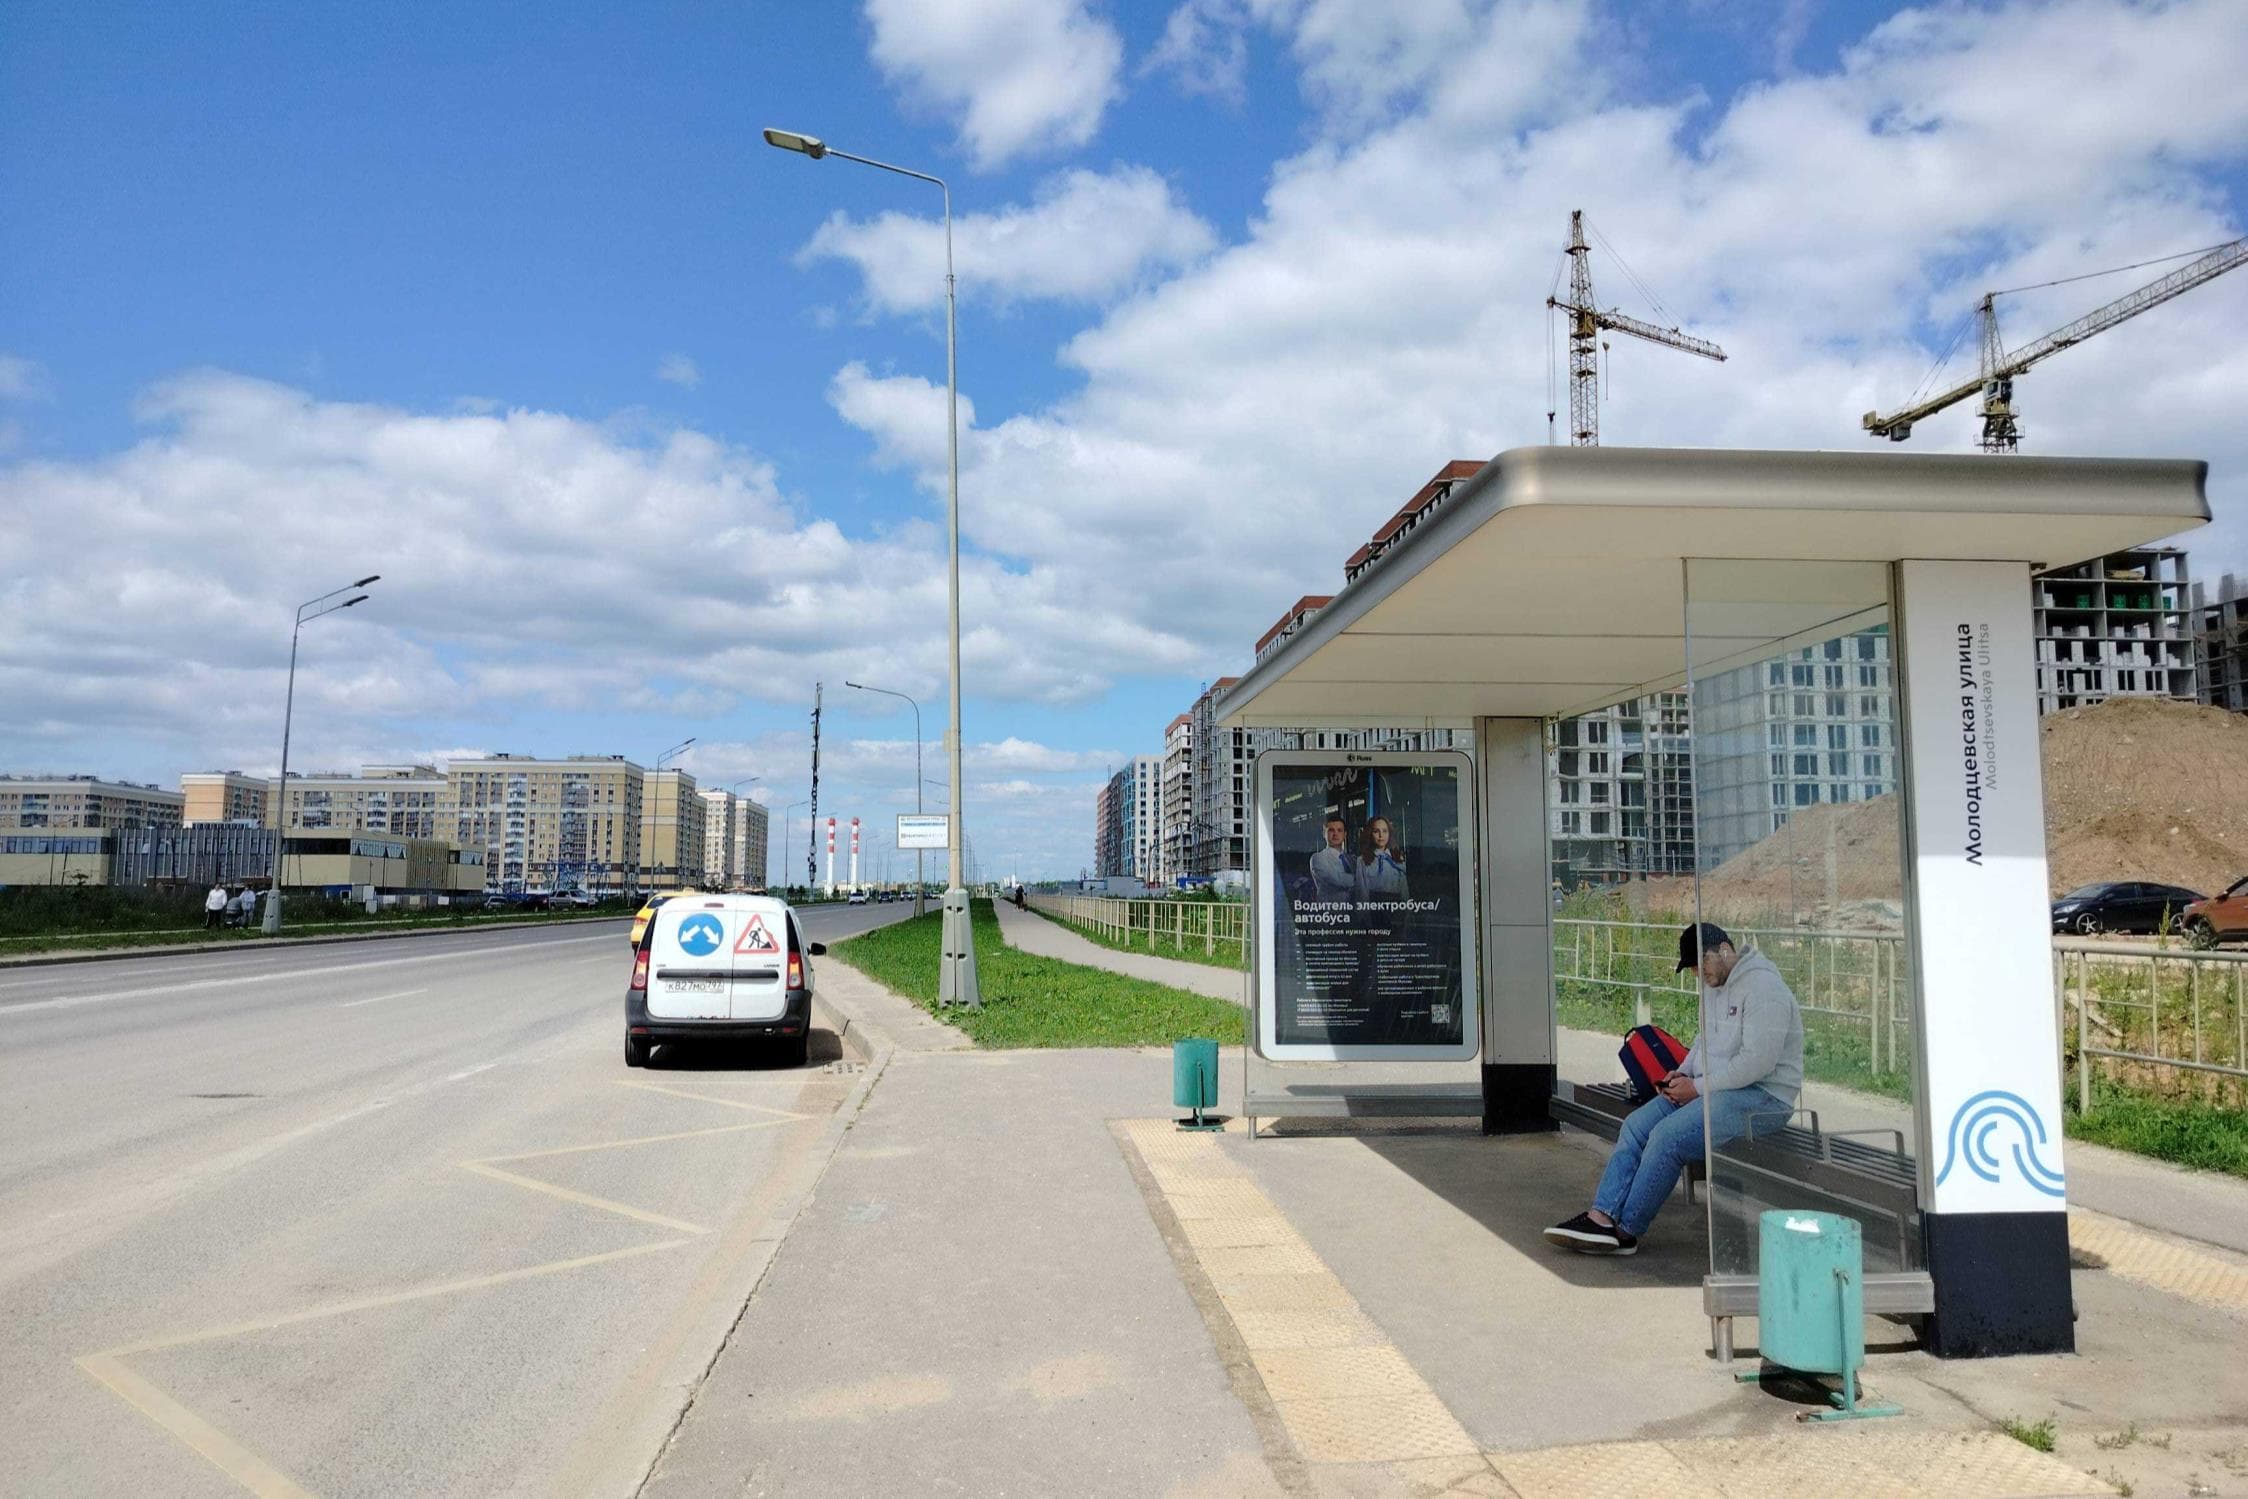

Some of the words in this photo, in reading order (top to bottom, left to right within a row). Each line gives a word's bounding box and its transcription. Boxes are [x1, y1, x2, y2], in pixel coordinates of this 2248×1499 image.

[1958, 624, 1977, 689] улица
[1978, 624, 1990, 665] Ulitsa
[1981, 670, 1997, 790] Molodtsevskaya
[1962, 696, 1982, 866] Молодцевская
[1294, 900, 1353, 912] Водитель
[1356, 899, 1440, 912] электробуса/
[1294, 912, 1350, 925] автобуса
[1308, 928, 1344, 936] профессия
[1368, 928, 1391, 936] городу
